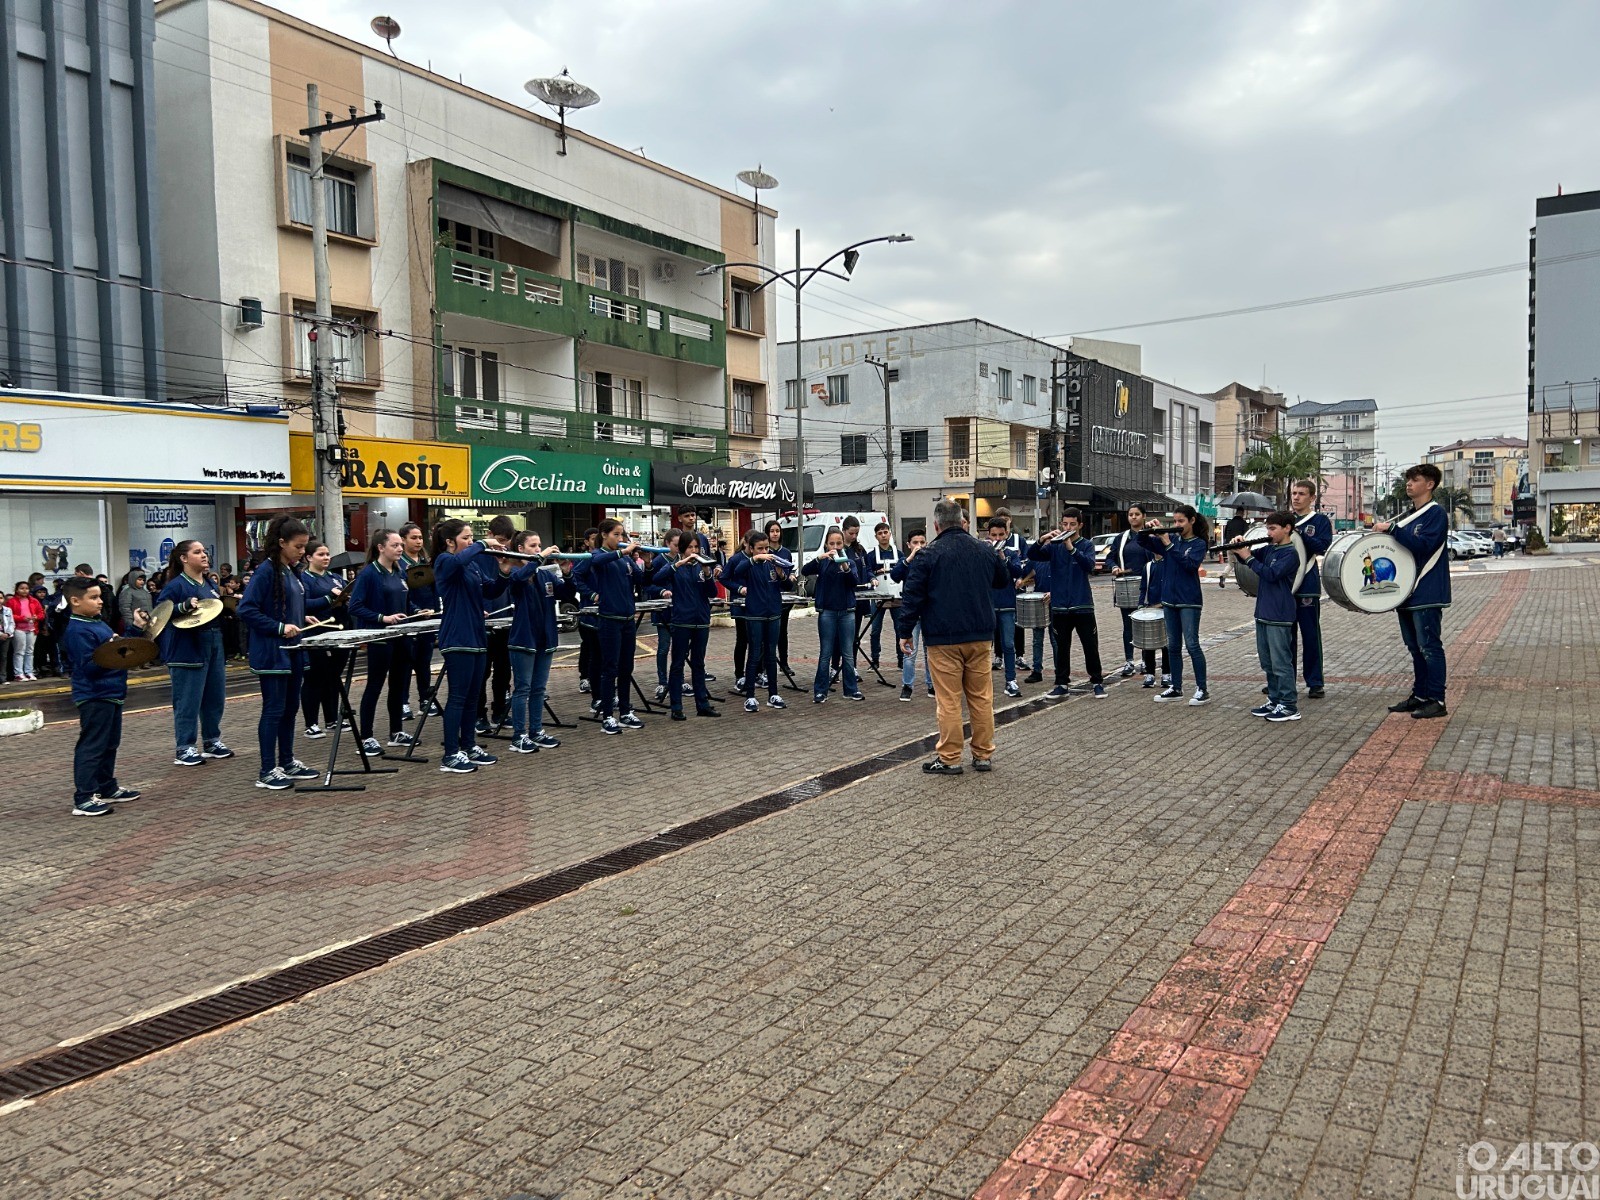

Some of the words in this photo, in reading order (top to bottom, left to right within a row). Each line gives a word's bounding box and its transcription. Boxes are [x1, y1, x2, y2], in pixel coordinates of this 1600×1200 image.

[818, 336, 925, 368] HOTEL
[1068, 362, 1082, 437] HOTE
[202, 467, 218, 478] Viva
[260, 469, 286, 482] Digitais
[479, 454, 587, 494] Getelina
[602, 458, 630, 477] Ótica
[632, 465, 642, 477] &
[597, 483, 645, 497] Joalheria
[682, 474, 727, 497] Calçados
[728, 480, 777, 500] TREVISOL
[144, 505, 188, 523] Internet
